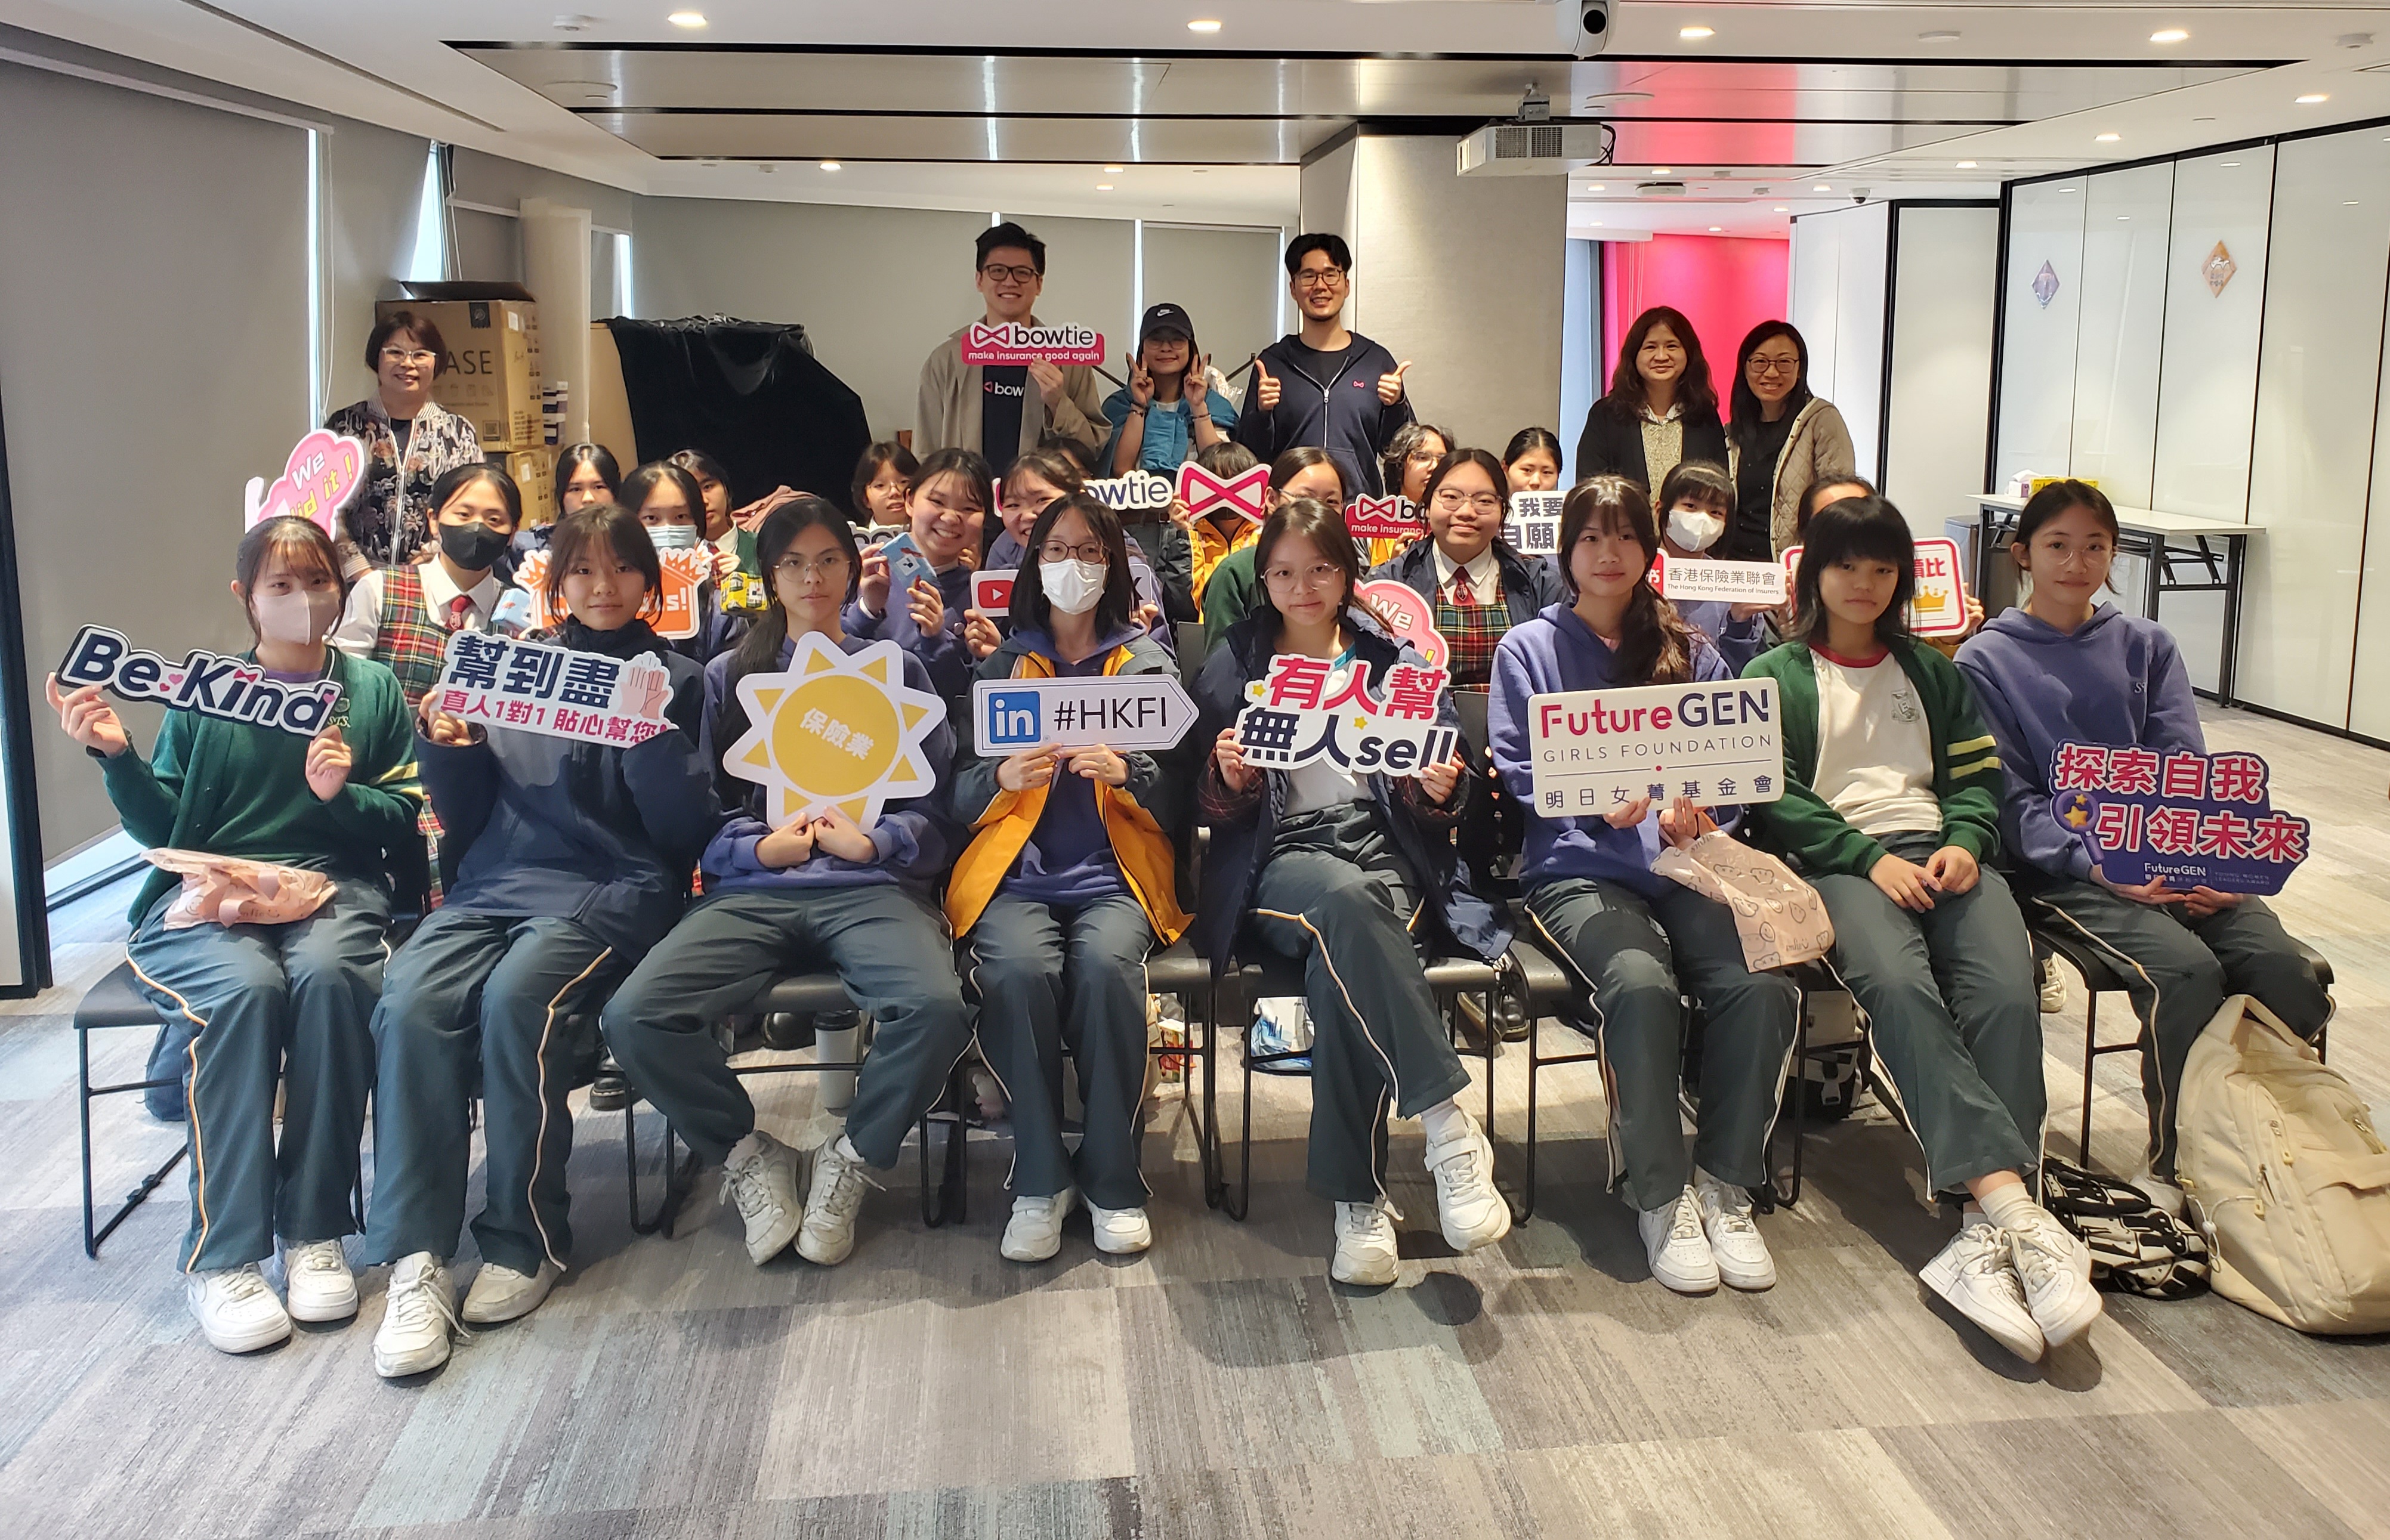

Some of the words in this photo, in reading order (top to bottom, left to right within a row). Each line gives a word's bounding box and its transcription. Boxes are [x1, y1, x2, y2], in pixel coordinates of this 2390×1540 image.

[1015, 326, 1094, 345] bowtie
[444, 350, 493, 375] ASE
[968, 351, 994, 360] make
[1045, 351, 1069, 362] good
[1072, 351, 1100, 362] again
[995, 382, 1024, 397] bow
[291, 451, 325, 491] We
[323, 469, 340, 502] it
[1518, 497, 1563, 518] 我要
[1351, 524, 1378, 533] make
[1380, 524, 1423, 534] insuranc
[1504, 522, 1561, 549] 自願
[1668, 567, 1776, 586] 香港保險業聯會
[67, 633, 160, 692] Be
[176, 658, 338, 732] Kind
[449, 635, 620, 709] 幫到盡
[1270, 658, 1447, 720] 有人幫
[995, 699, 1034, 737] in
[1054, 697, 1166, 731] #HKFI
[1540, 689, 1770, 738] FutureGEN
[799, 707, 875, 760] 保險業
[1543, 747, 1608, 762] GIRLS
[1622, 734, 1771, 757] FOUNDATION
[2054, 746, 2265, 803] 探索自我
[2095, 805, 2305, 862] 引領未來
[2144, 863, 2206, 876] FutureGEN
